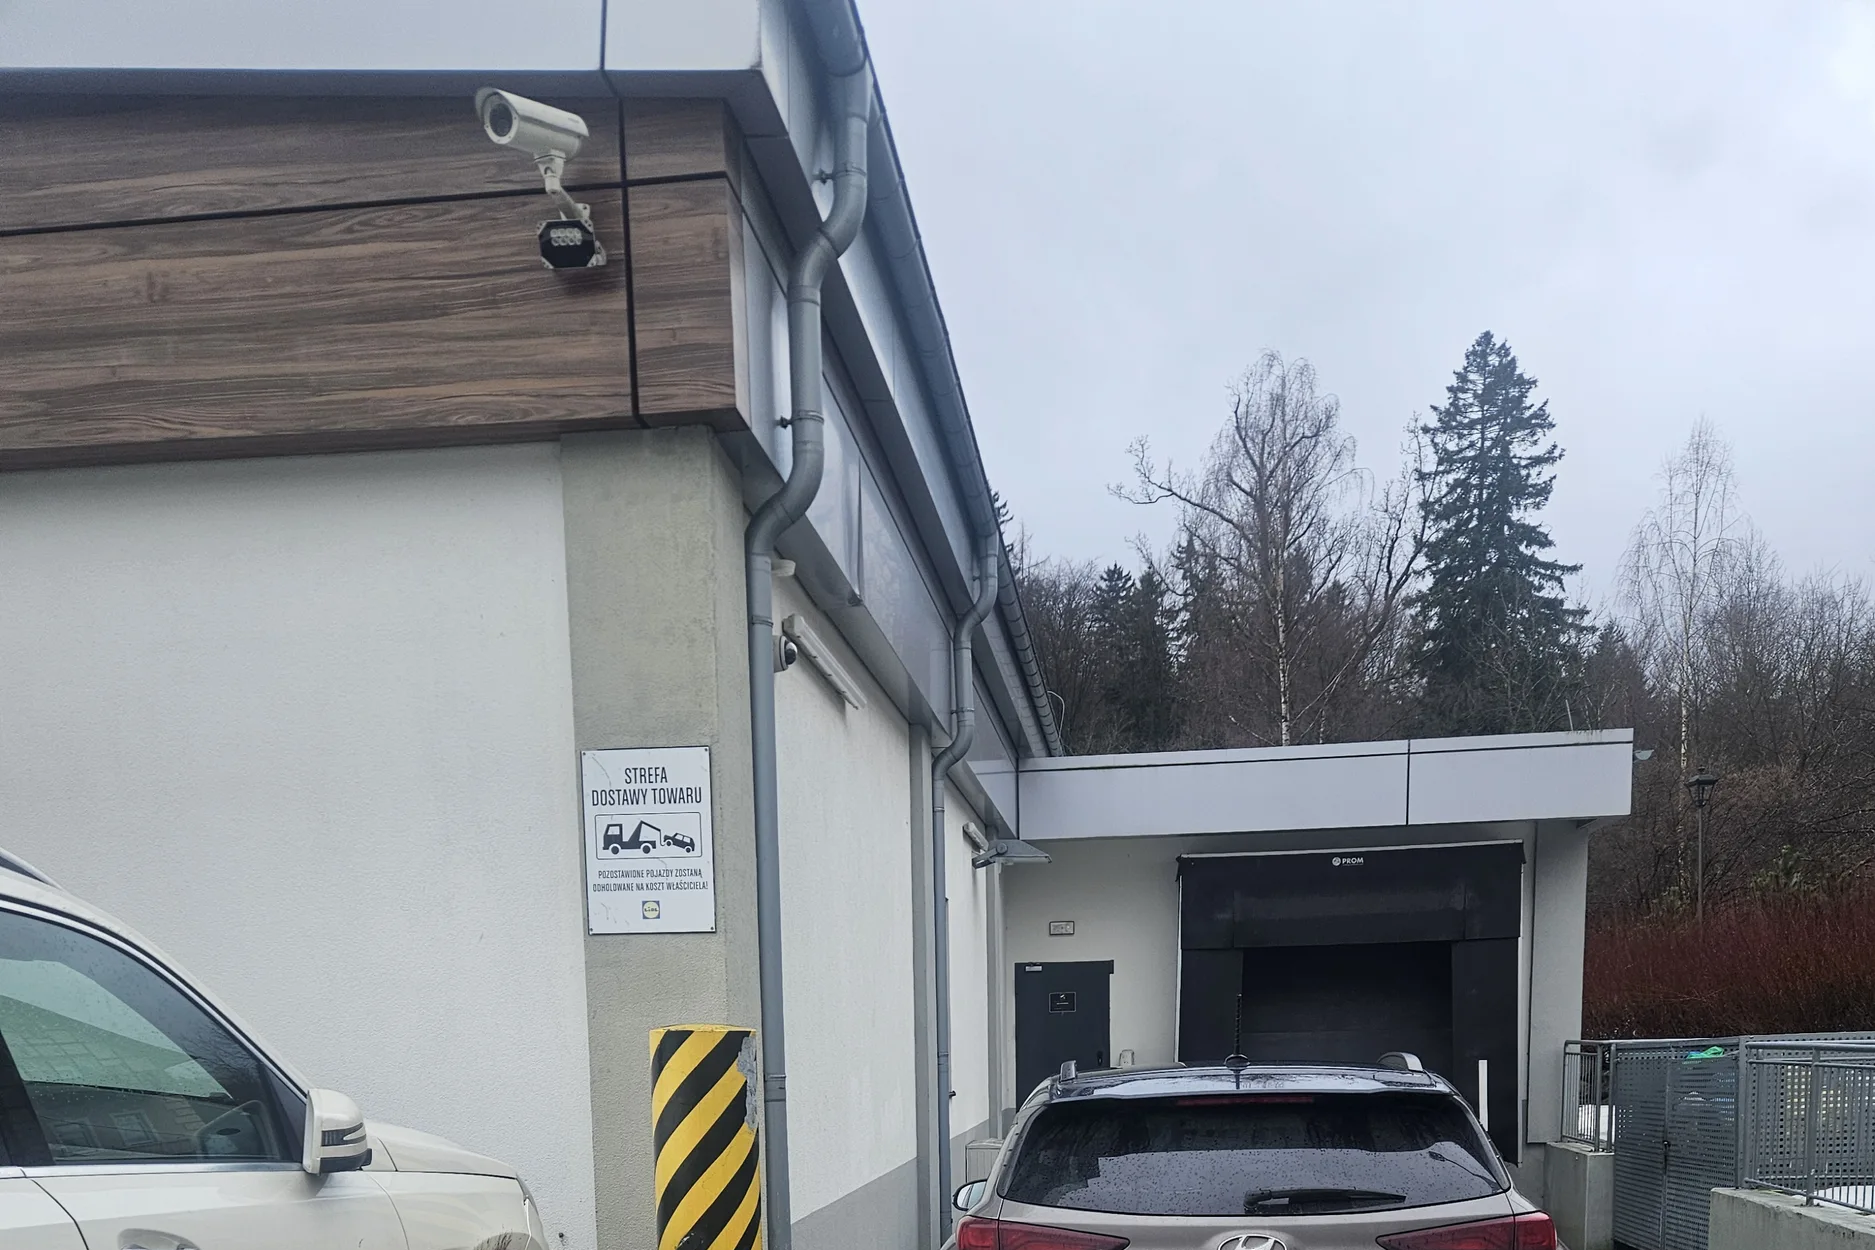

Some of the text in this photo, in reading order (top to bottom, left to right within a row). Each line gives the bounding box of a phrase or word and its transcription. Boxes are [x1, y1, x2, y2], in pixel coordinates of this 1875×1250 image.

[624, 766, 668, 784] STREFA
[592, 786, 702, 806] DOSTAWY TOWARU
[598, 868, 703, 879] POZOSTAWIONE POJAZDY ZOSTANĄ
[592, 880, 708, 892] ODHOLOWANE NA KOSZT WŁAŚCICIELA!
